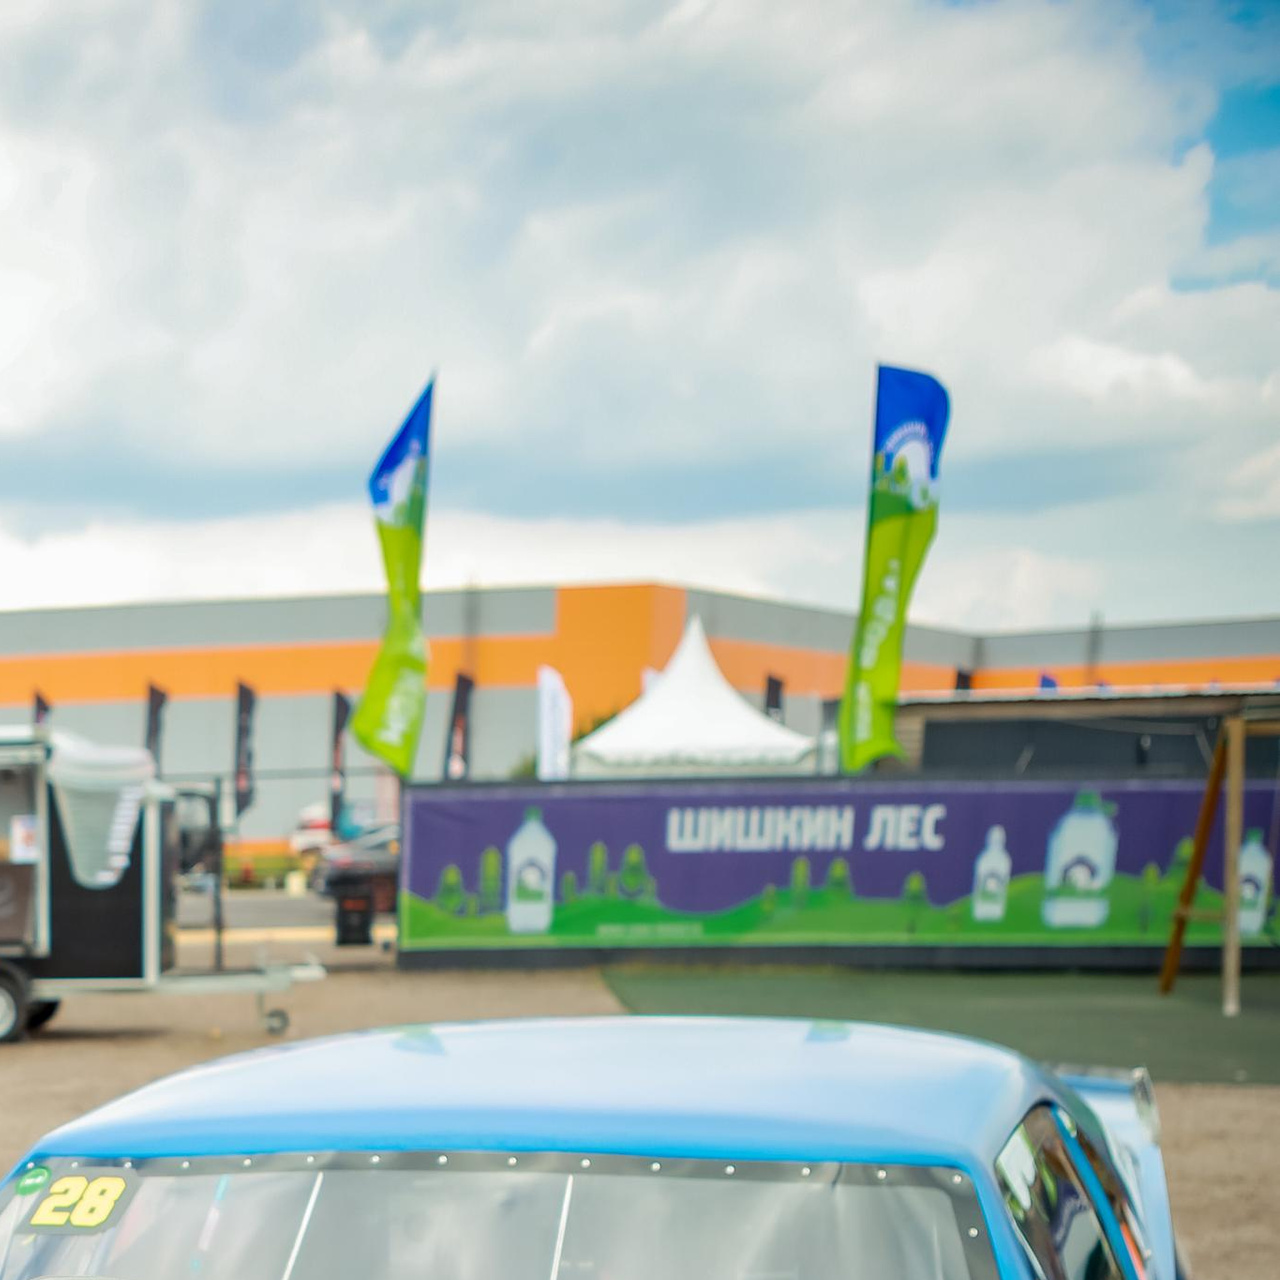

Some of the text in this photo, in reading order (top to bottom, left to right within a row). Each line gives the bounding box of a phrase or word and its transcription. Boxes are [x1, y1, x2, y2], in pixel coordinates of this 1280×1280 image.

[666, 803, 947, 852] ШИШКИН ЛЕС
[30, 1175, 127, 1227] 28
